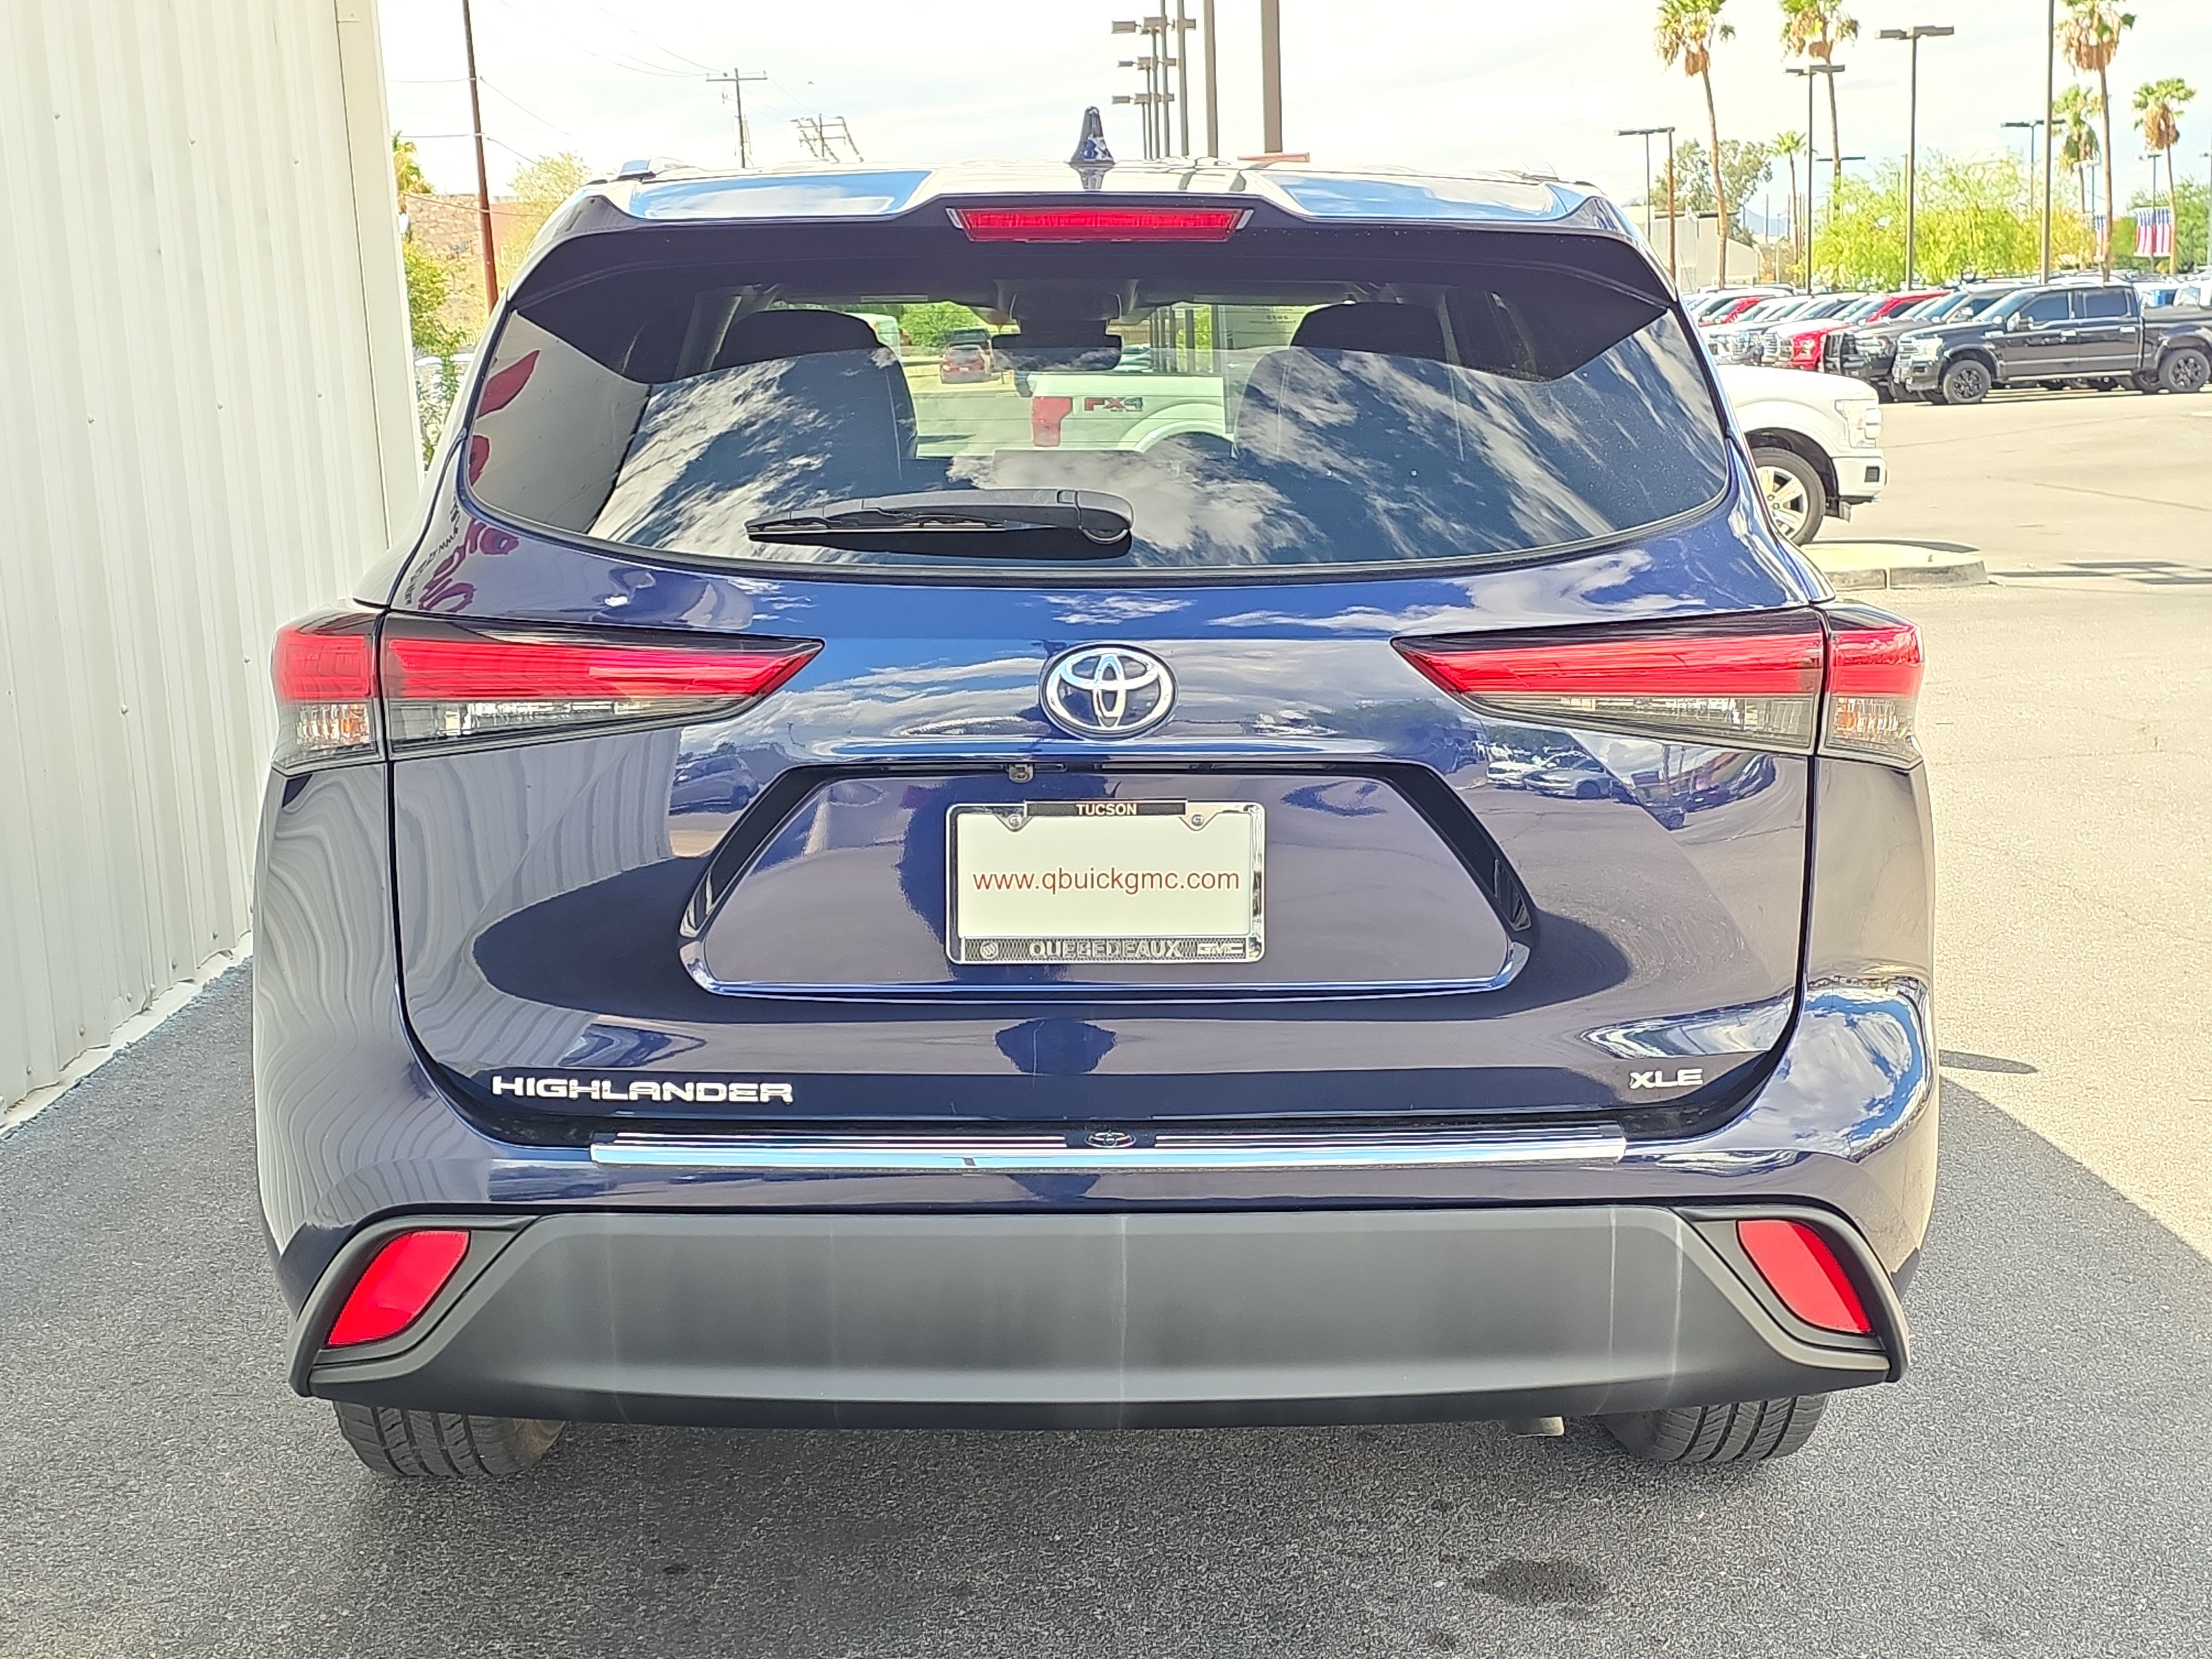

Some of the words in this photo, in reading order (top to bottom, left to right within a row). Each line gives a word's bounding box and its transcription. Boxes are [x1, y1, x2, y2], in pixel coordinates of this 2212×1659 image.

[1084, 397, 1143, 411] FX4
[1076, 803, 1137, 815] TUCSON
[973, 867, 1239, 895] www.qbuickgmc.com
[1629, 1068, 1703, 1089] XLE
[492, 1076, 793, 1104] HIGHLANDER
